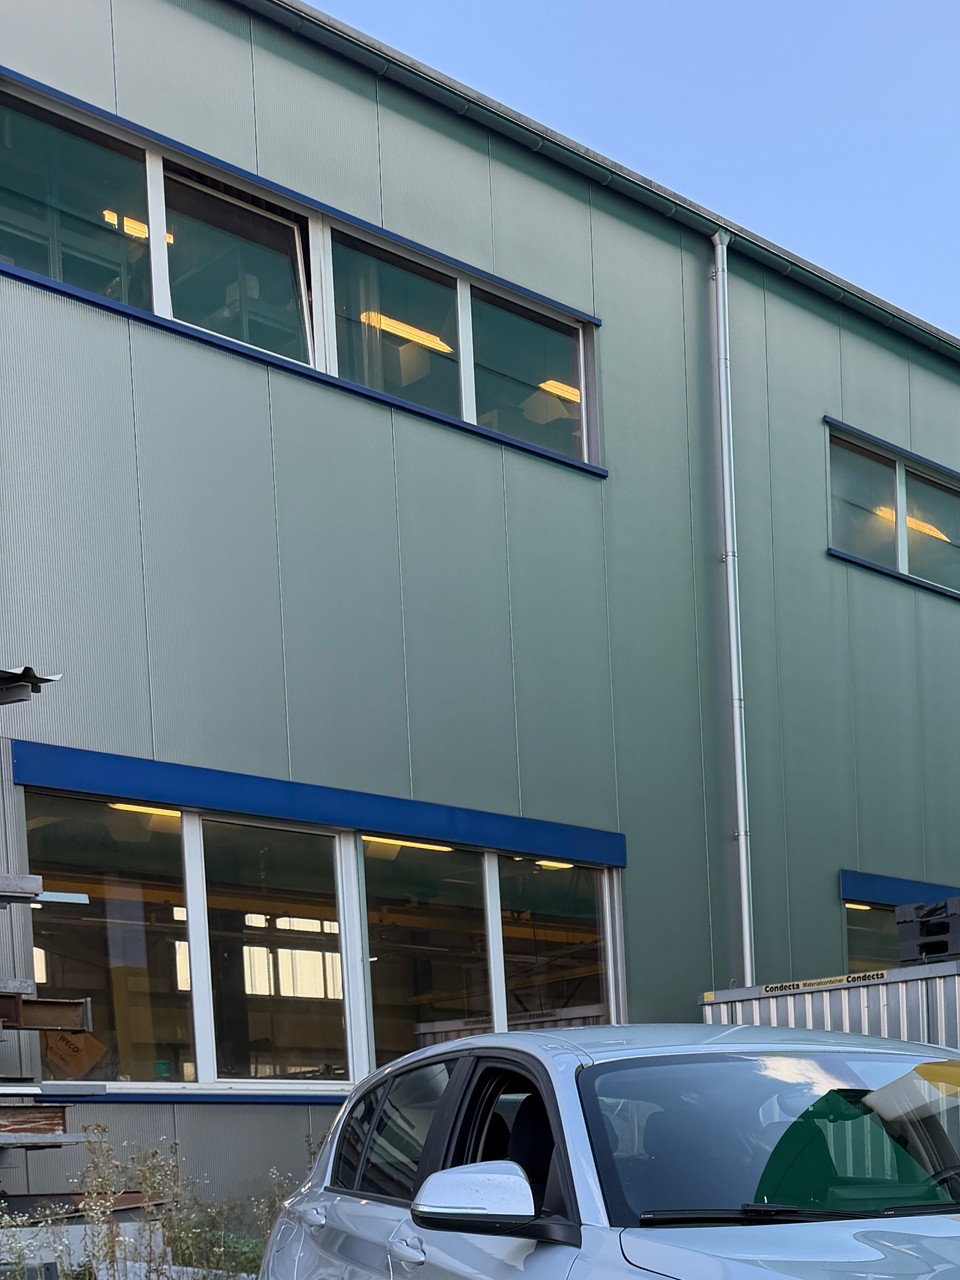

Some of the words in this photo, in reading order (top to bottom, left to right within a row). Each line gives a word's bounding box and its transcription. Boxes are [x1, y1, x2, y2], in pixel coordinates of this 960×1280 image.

[764, 982, 800, 993] Condecta
[802, 978, 844, 988] Materialcontainer
[846, 972, 885, 983] Condecta
